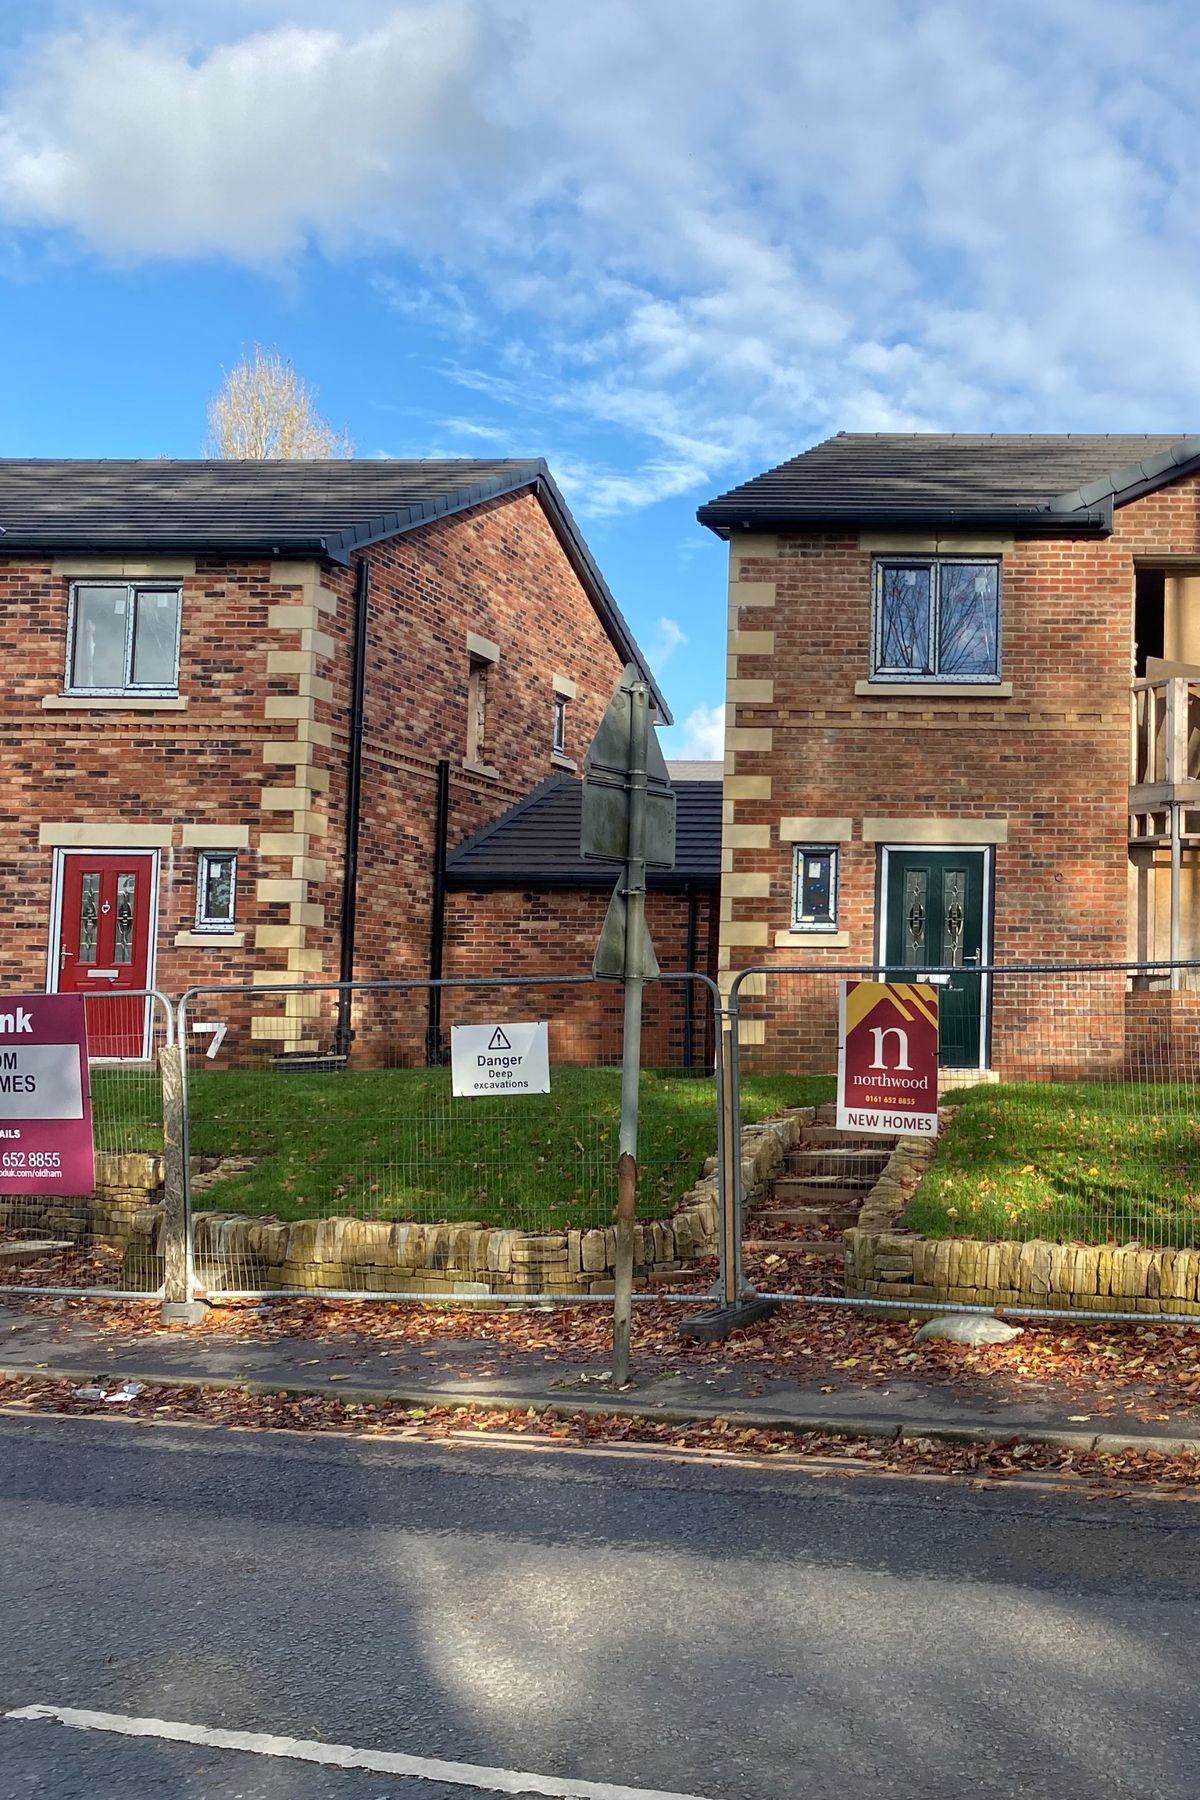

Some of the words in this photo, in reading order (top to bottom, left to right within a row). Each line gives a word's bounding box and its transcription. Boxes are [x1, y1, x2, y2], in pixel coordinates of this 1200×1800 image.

[0, 1052, 17, 1070] M
[477, 1056, 523, 1068] Danger
[488, 1070, 513, 1079] Deep
[853, 1073, 929, 1090] northwood
[473, 1080, 529, 1089] excavations
[848, 1113, 879, 1127] NEW
[883, 1115, 932, 1131] HOMES
[2, 1152, 26, 1167] 652
[28, 1152, 61, 1167] 8855
